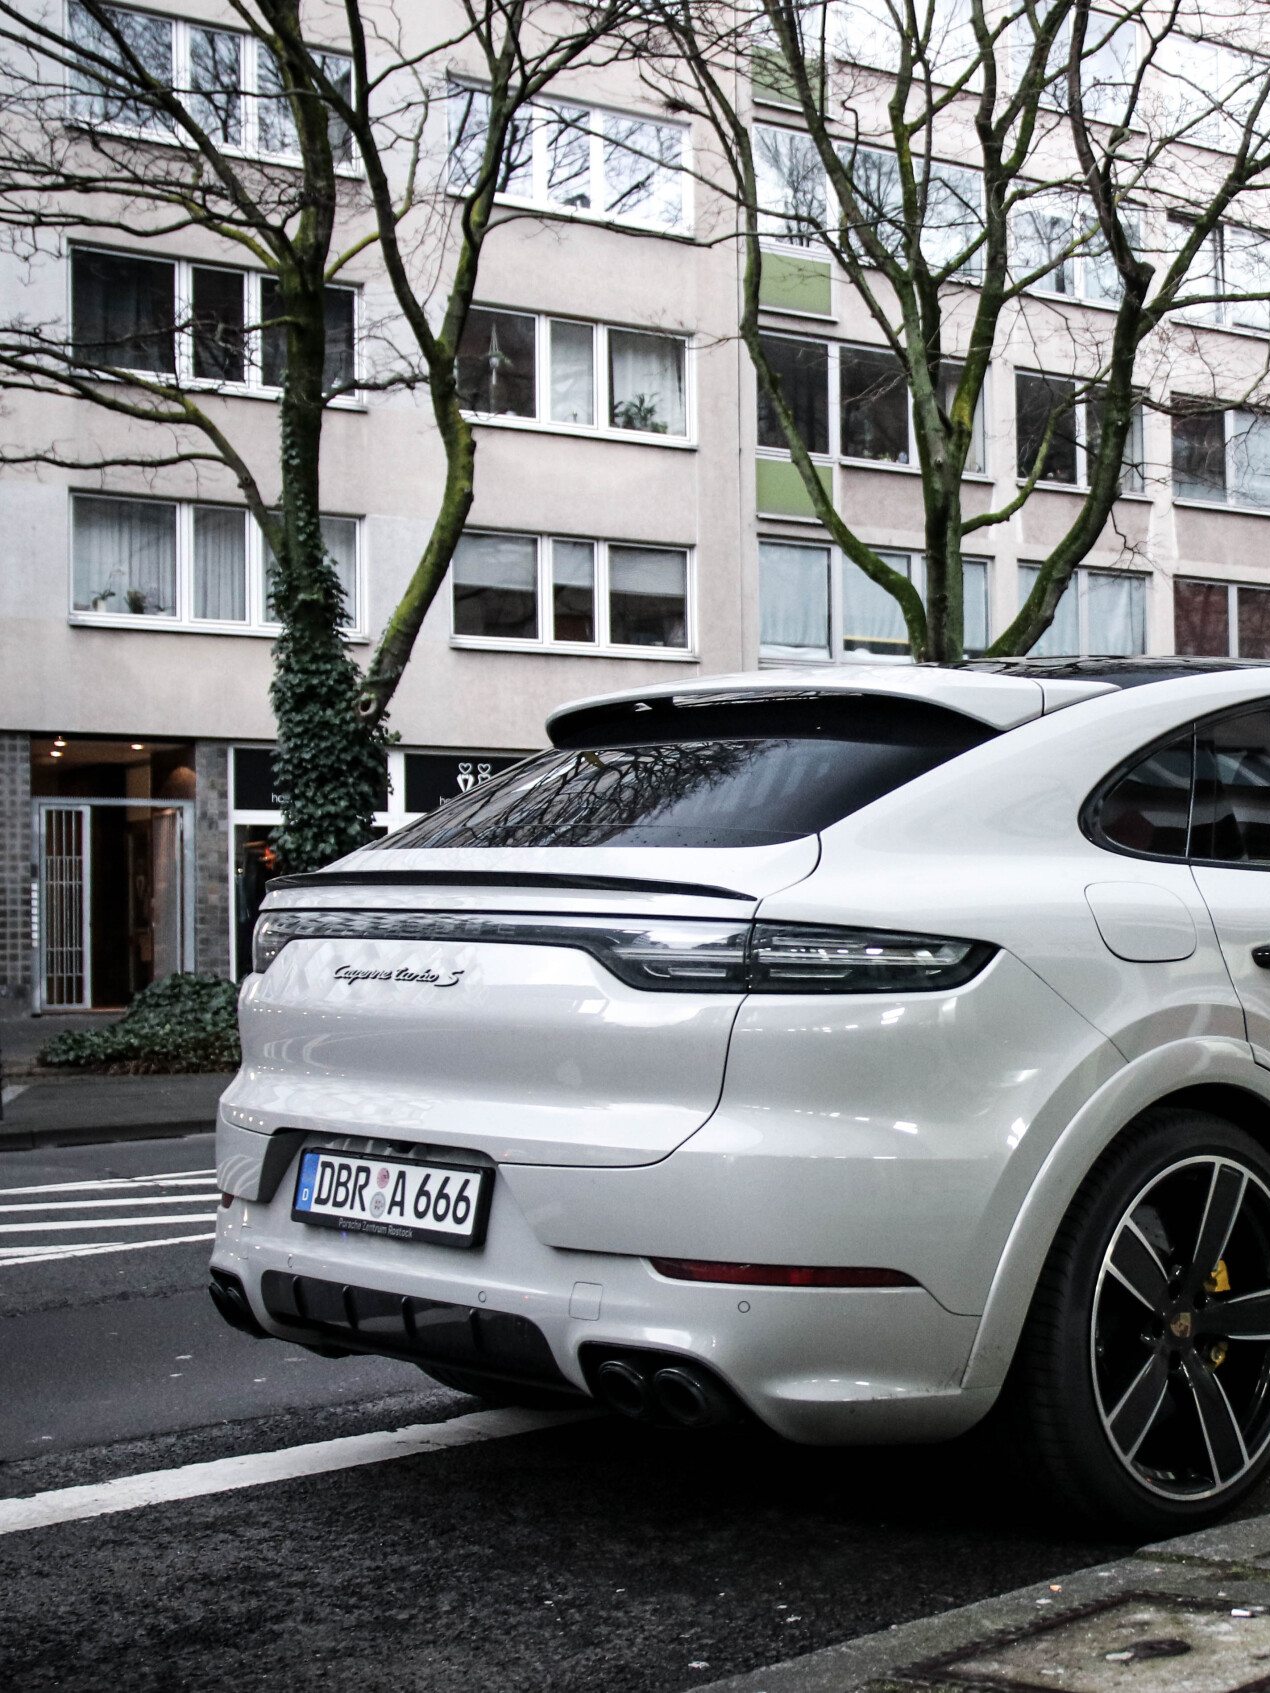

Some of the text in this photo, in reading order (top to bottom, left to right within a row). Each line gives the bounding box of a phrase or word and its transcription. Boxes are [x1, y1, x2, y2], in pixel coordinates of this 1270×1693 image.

[333, 965, 392, 985] Cayenne
[433, 970, 465, 988] S
[314, 1160, 471, 1225] DBR A 666
[338, 1218, 413, 1238] Porsche Zentrum Rostock
